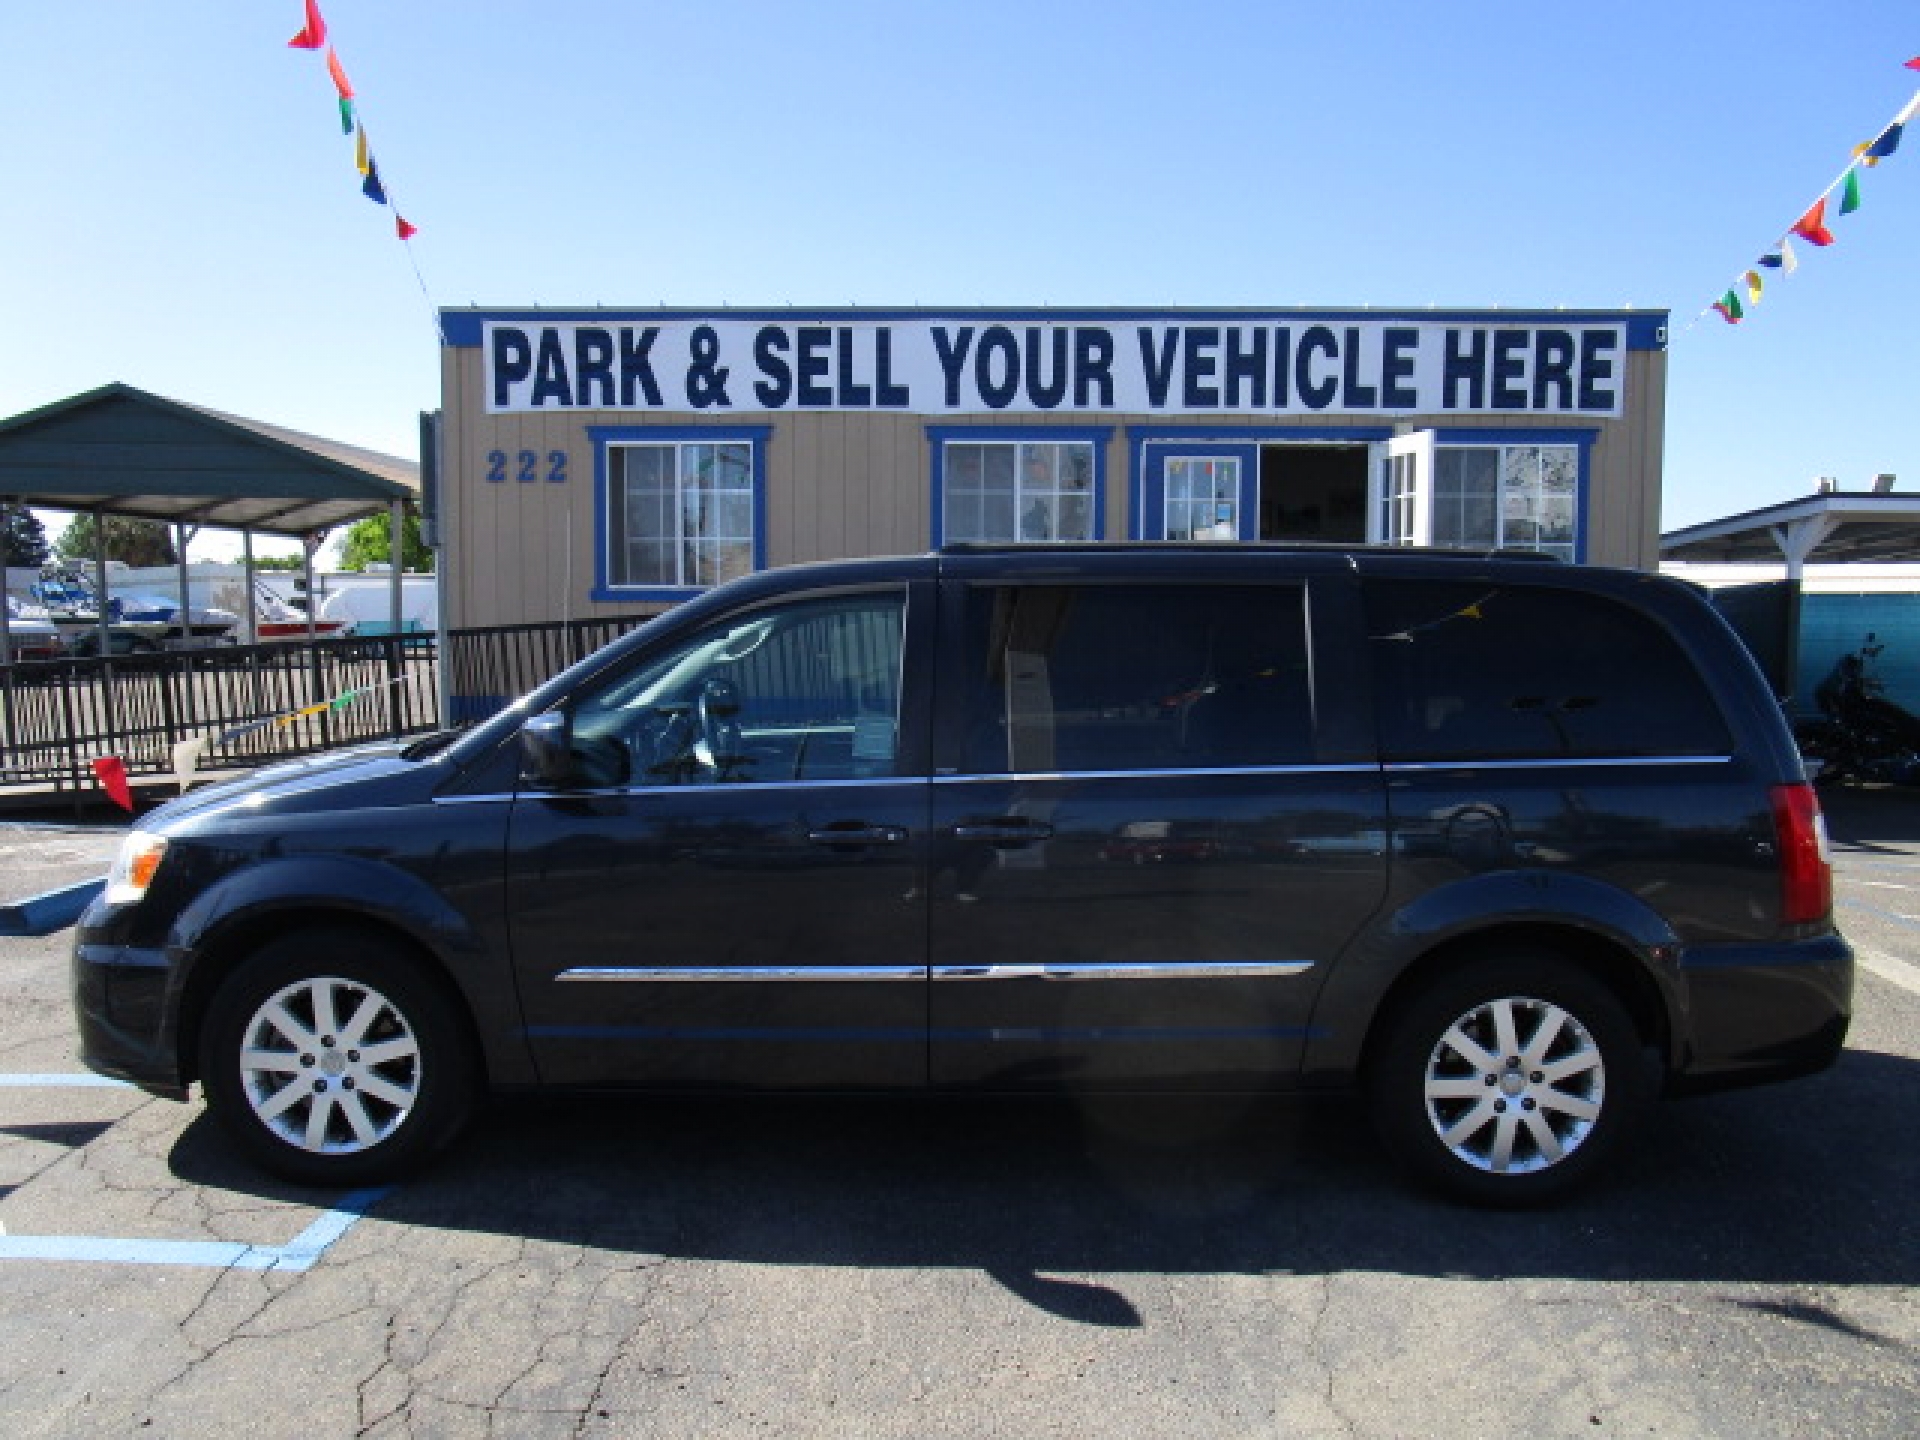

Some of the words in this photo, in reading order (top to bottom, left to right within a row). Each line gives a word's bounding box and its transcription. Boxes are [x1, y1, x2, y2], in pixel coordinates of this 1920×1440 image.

[492, 327, 664, 408] PARK
[685, 325, 732, 408] &
[753, 325, 910, 408] SELL
[931, 326, 1114, 409] YOUR
[1137, 325, 1419, 410] VEHICLE
[1442, 329, 1618, 409] HERE
[486, 449, 568, 483] 222
